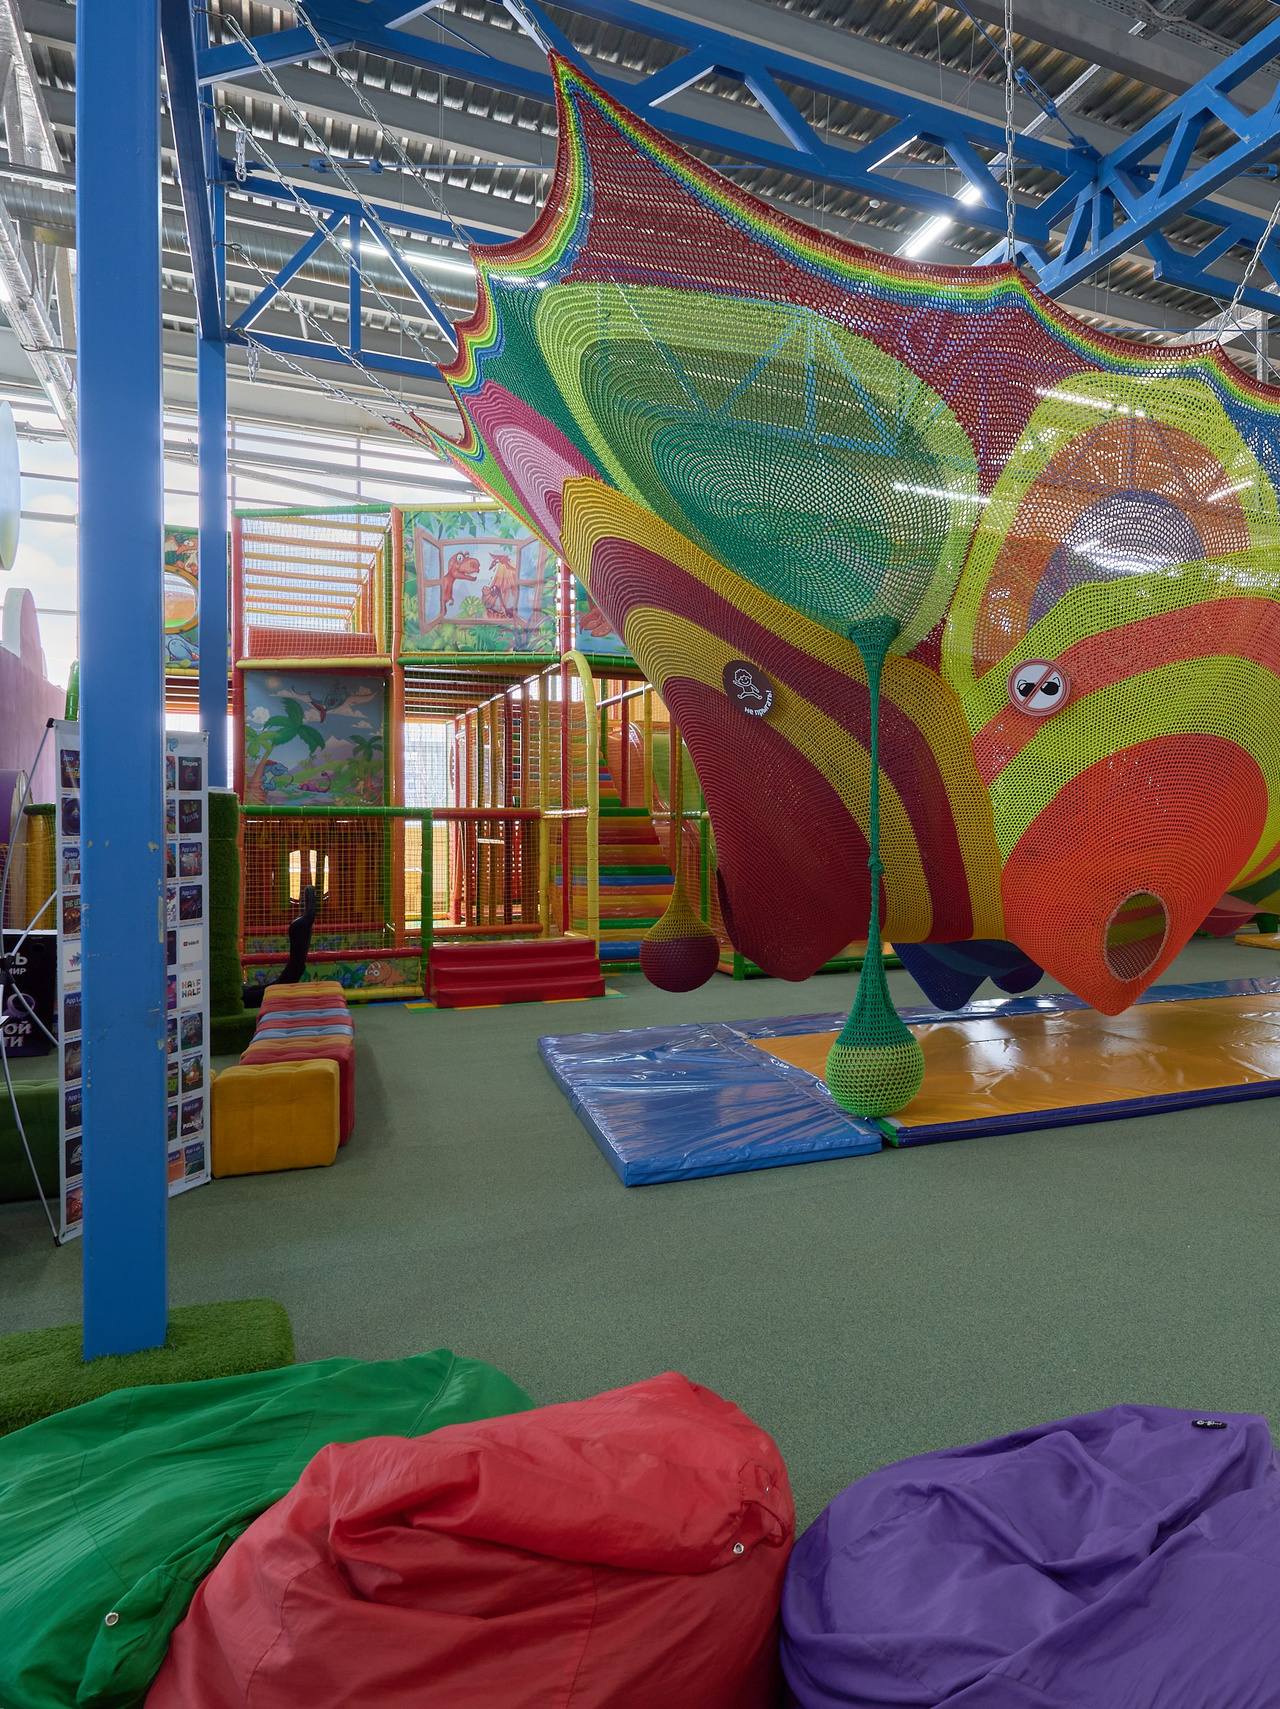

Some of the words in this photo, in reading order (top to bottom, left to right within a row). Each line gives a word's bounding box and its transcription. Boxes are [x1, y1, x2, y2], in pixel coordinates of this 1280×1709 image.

[182, 979, 201, 989] HALF
[182, 988, 201, 998] HALF
[4, 1021, 32, 1035] ОЙ
